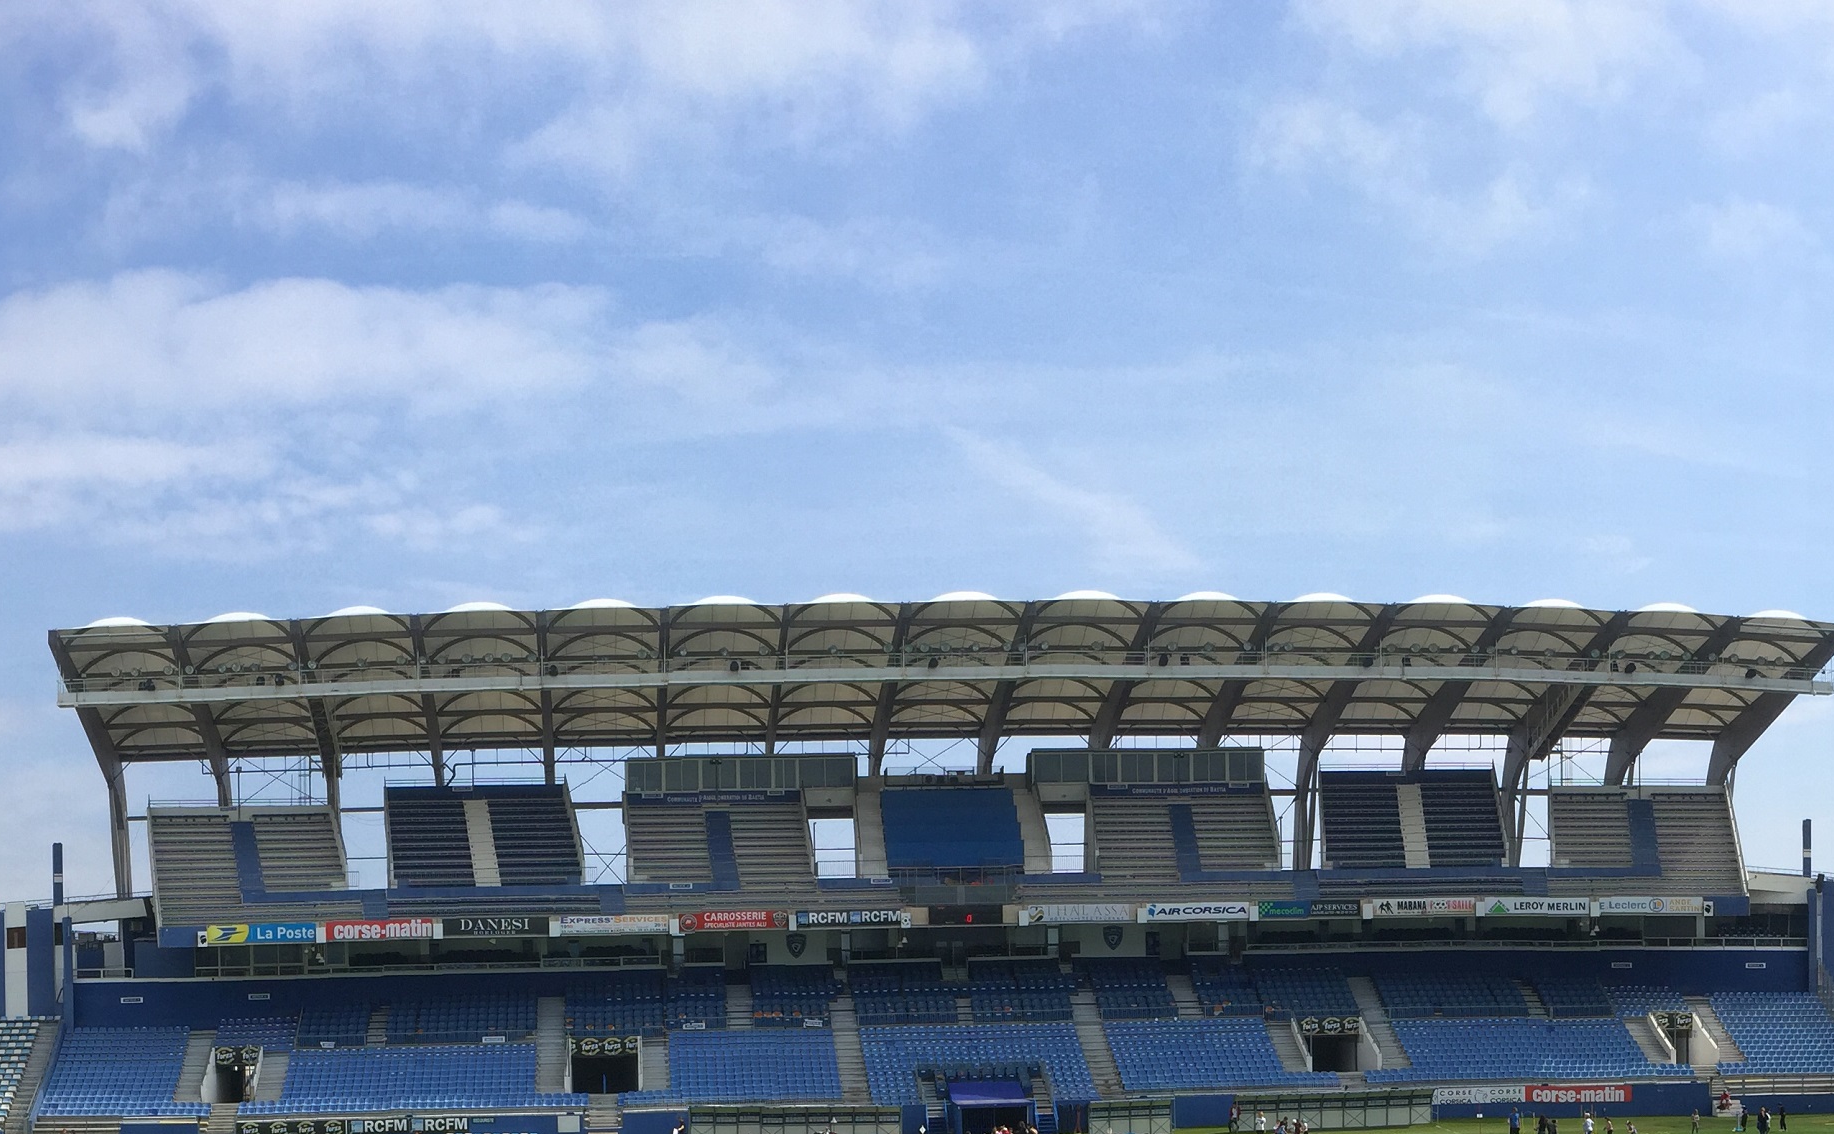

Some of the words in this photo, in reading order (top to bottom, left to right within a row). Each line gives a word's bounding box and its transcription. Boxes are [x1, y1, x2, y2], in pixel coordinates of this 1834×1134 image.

[1047, 905, 1128, 916] THALASSA
[1156, 908, 1181, 916] AIR
[1182, 906, 1247, 914] CORSICA
[1514, 902, 1545, 910] LEROY
[1547, 902, 1585, 910] MERLIN
[703, 911, 767, 922] CARROSSERIE
[809, 912, 847, 924] RCFM
[861, 910, 901, 922] RCFM
[460, 918, 529, 930] DANESI
[736, 920, 755, 928] JANTES
[256, 926, 273, 939] La
[277, 926, 315, 939] Poste
[1491, 1096, 1522, 1104] CORSICA
[365, 1120, 408, 1132] RCFM
[424, 1118, 467, 1131] RCFM
